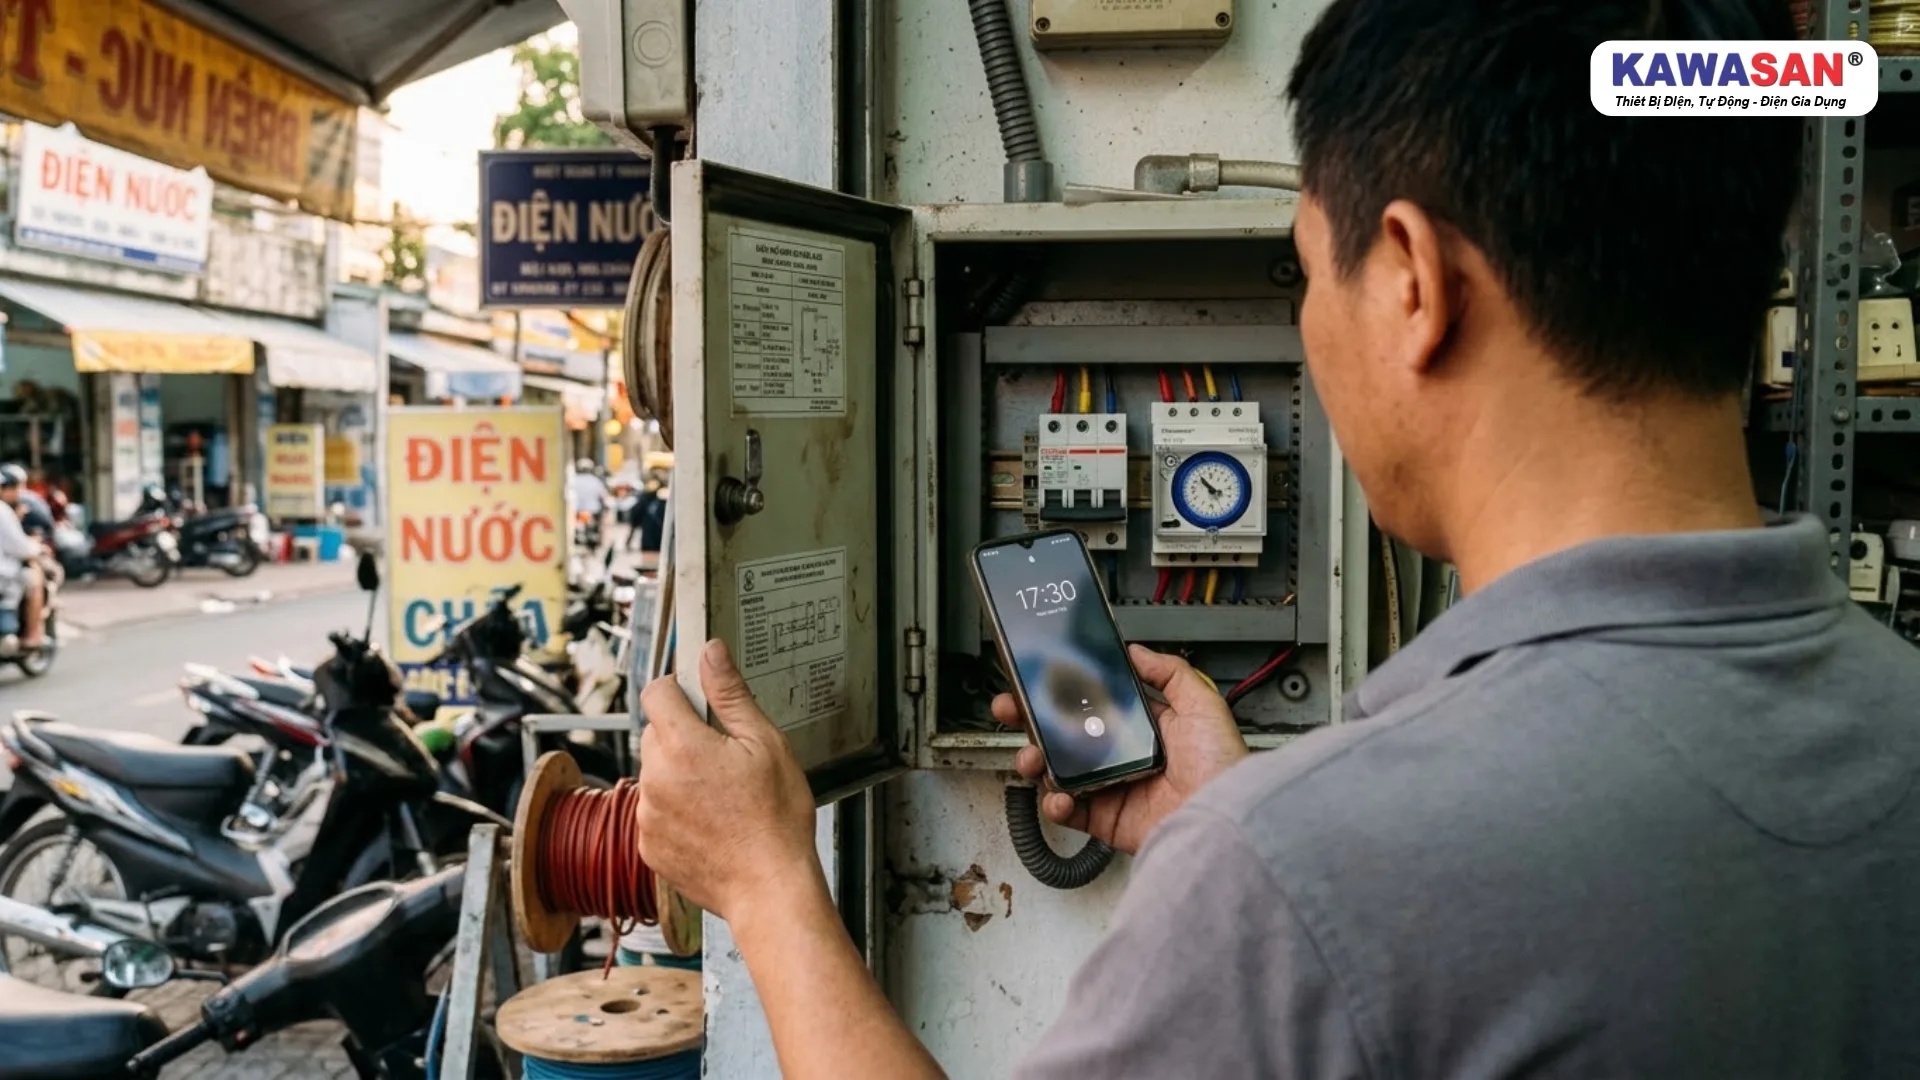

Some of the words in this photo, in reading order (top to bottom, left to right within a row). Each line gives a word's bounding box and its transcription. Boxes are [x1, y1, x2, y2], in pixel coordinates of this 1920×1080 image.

[492, 188, 578, 253] ĐIỆN
[405, 421, 546, 495] ĐIỆN
[401, 501, 554, 563] NƯỚC
[1015, 579, 1077, 610] 17:30
